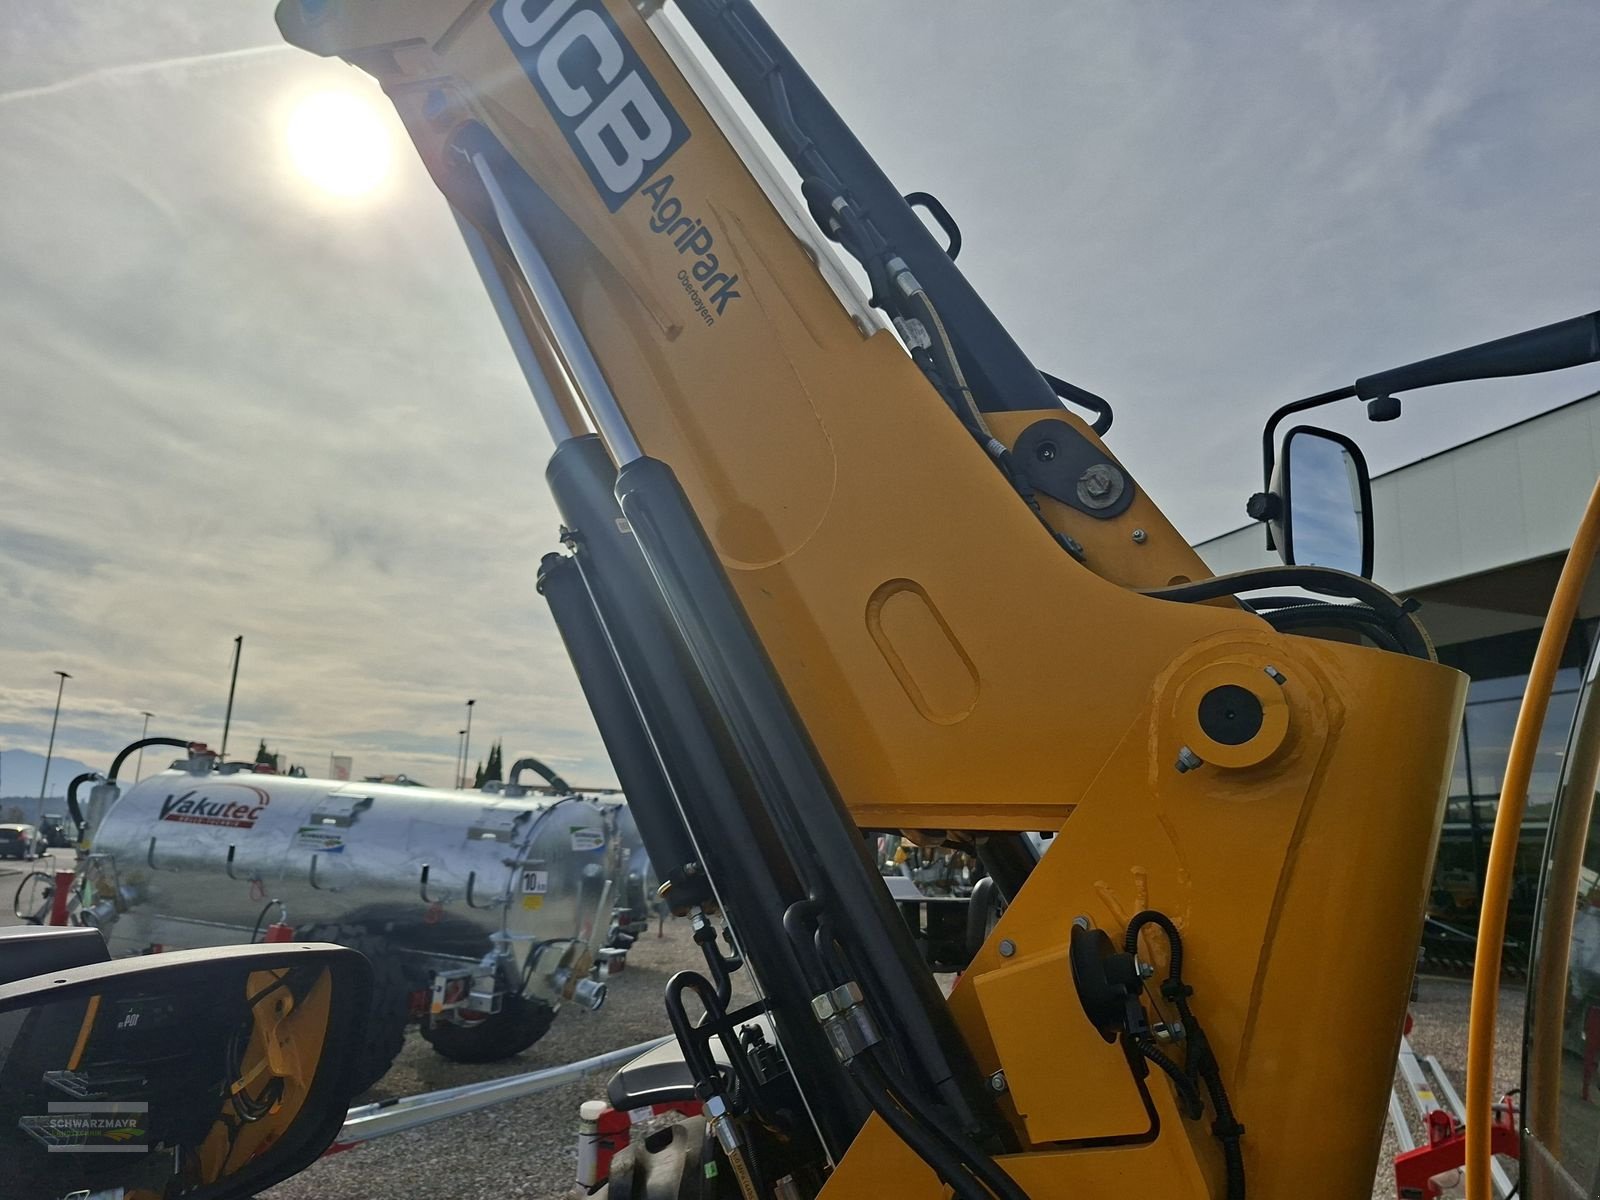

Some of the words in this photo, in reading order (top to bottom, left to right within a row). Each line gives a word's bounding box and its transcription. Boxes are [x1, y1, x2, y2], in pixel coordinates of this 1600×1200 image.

[502, 0, 672, 193] JCB
[641, 174, 741, 316] AgriPark
[677, 269, 714, 327] Oberbayern
[159, 790, 264, 820] Vakutec
[524, 873, 537, 891] 10
